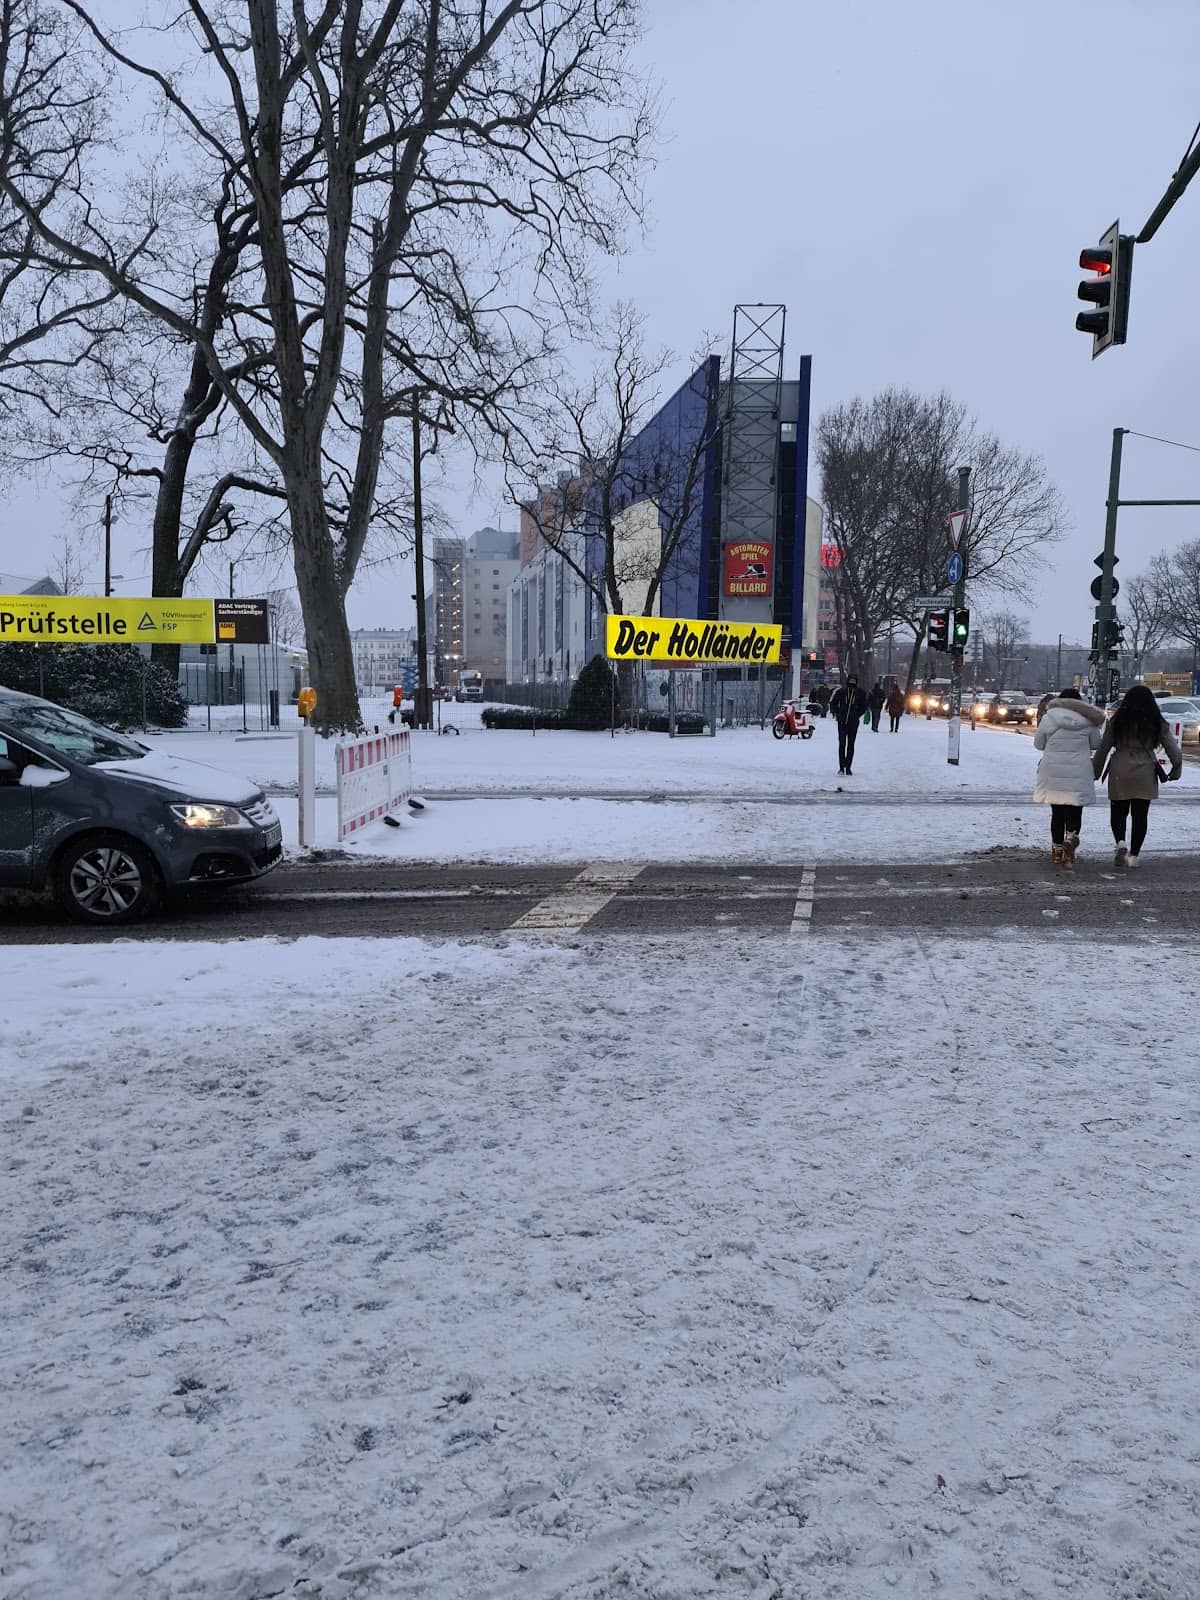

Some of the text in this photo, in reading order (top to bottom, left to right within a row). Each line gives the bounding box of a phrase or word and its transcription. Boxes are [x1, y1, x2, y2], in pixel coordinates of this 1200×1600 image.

[730, 543, 770, 556] AUTOMATEN
[740, 552, 758, 561] SPIEL
[730, 583, 767, 593] BILLARD
[0, 611, 127, 635] Prüfstelle
[162, 622, 178, 631] FSP
[614, 619, 775, 660] Der Holländer
